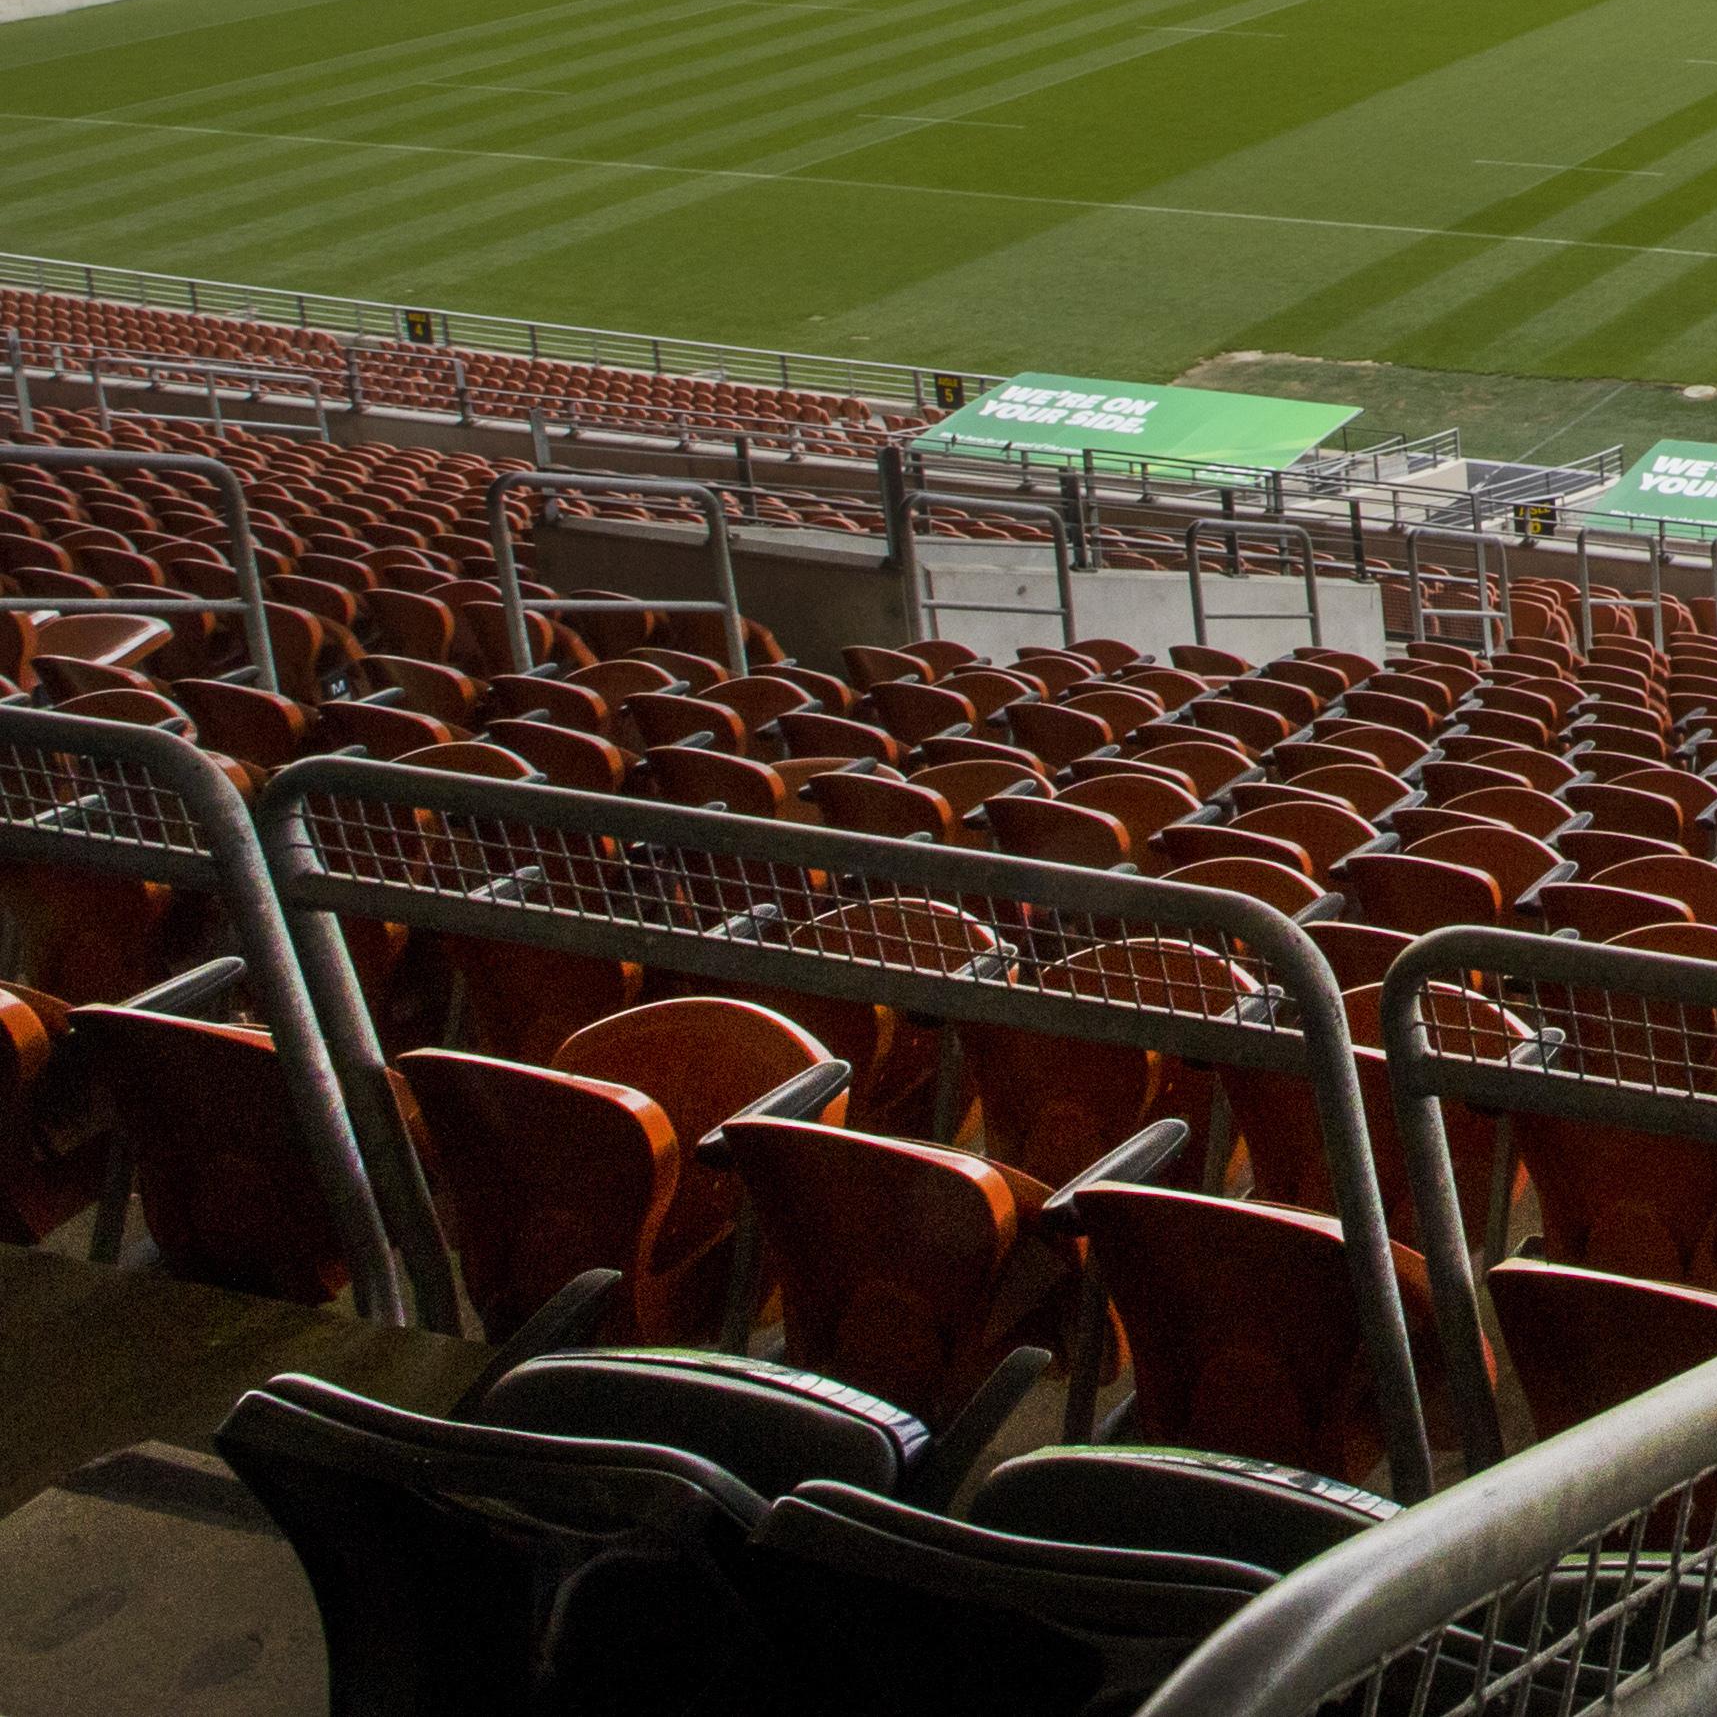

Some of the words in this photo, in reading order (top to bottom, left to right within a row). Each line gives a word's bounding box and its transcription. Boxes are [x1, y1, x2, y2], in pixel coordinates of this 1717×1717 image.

[944, 388, 954, 403] 5
[999, 385, 1108, 409] WE'RE
[1101, 397, 1158, 416] ON
[978, 400, 1069, 424] YOUR
[1064, 409, 1147, 434] SIDE.
